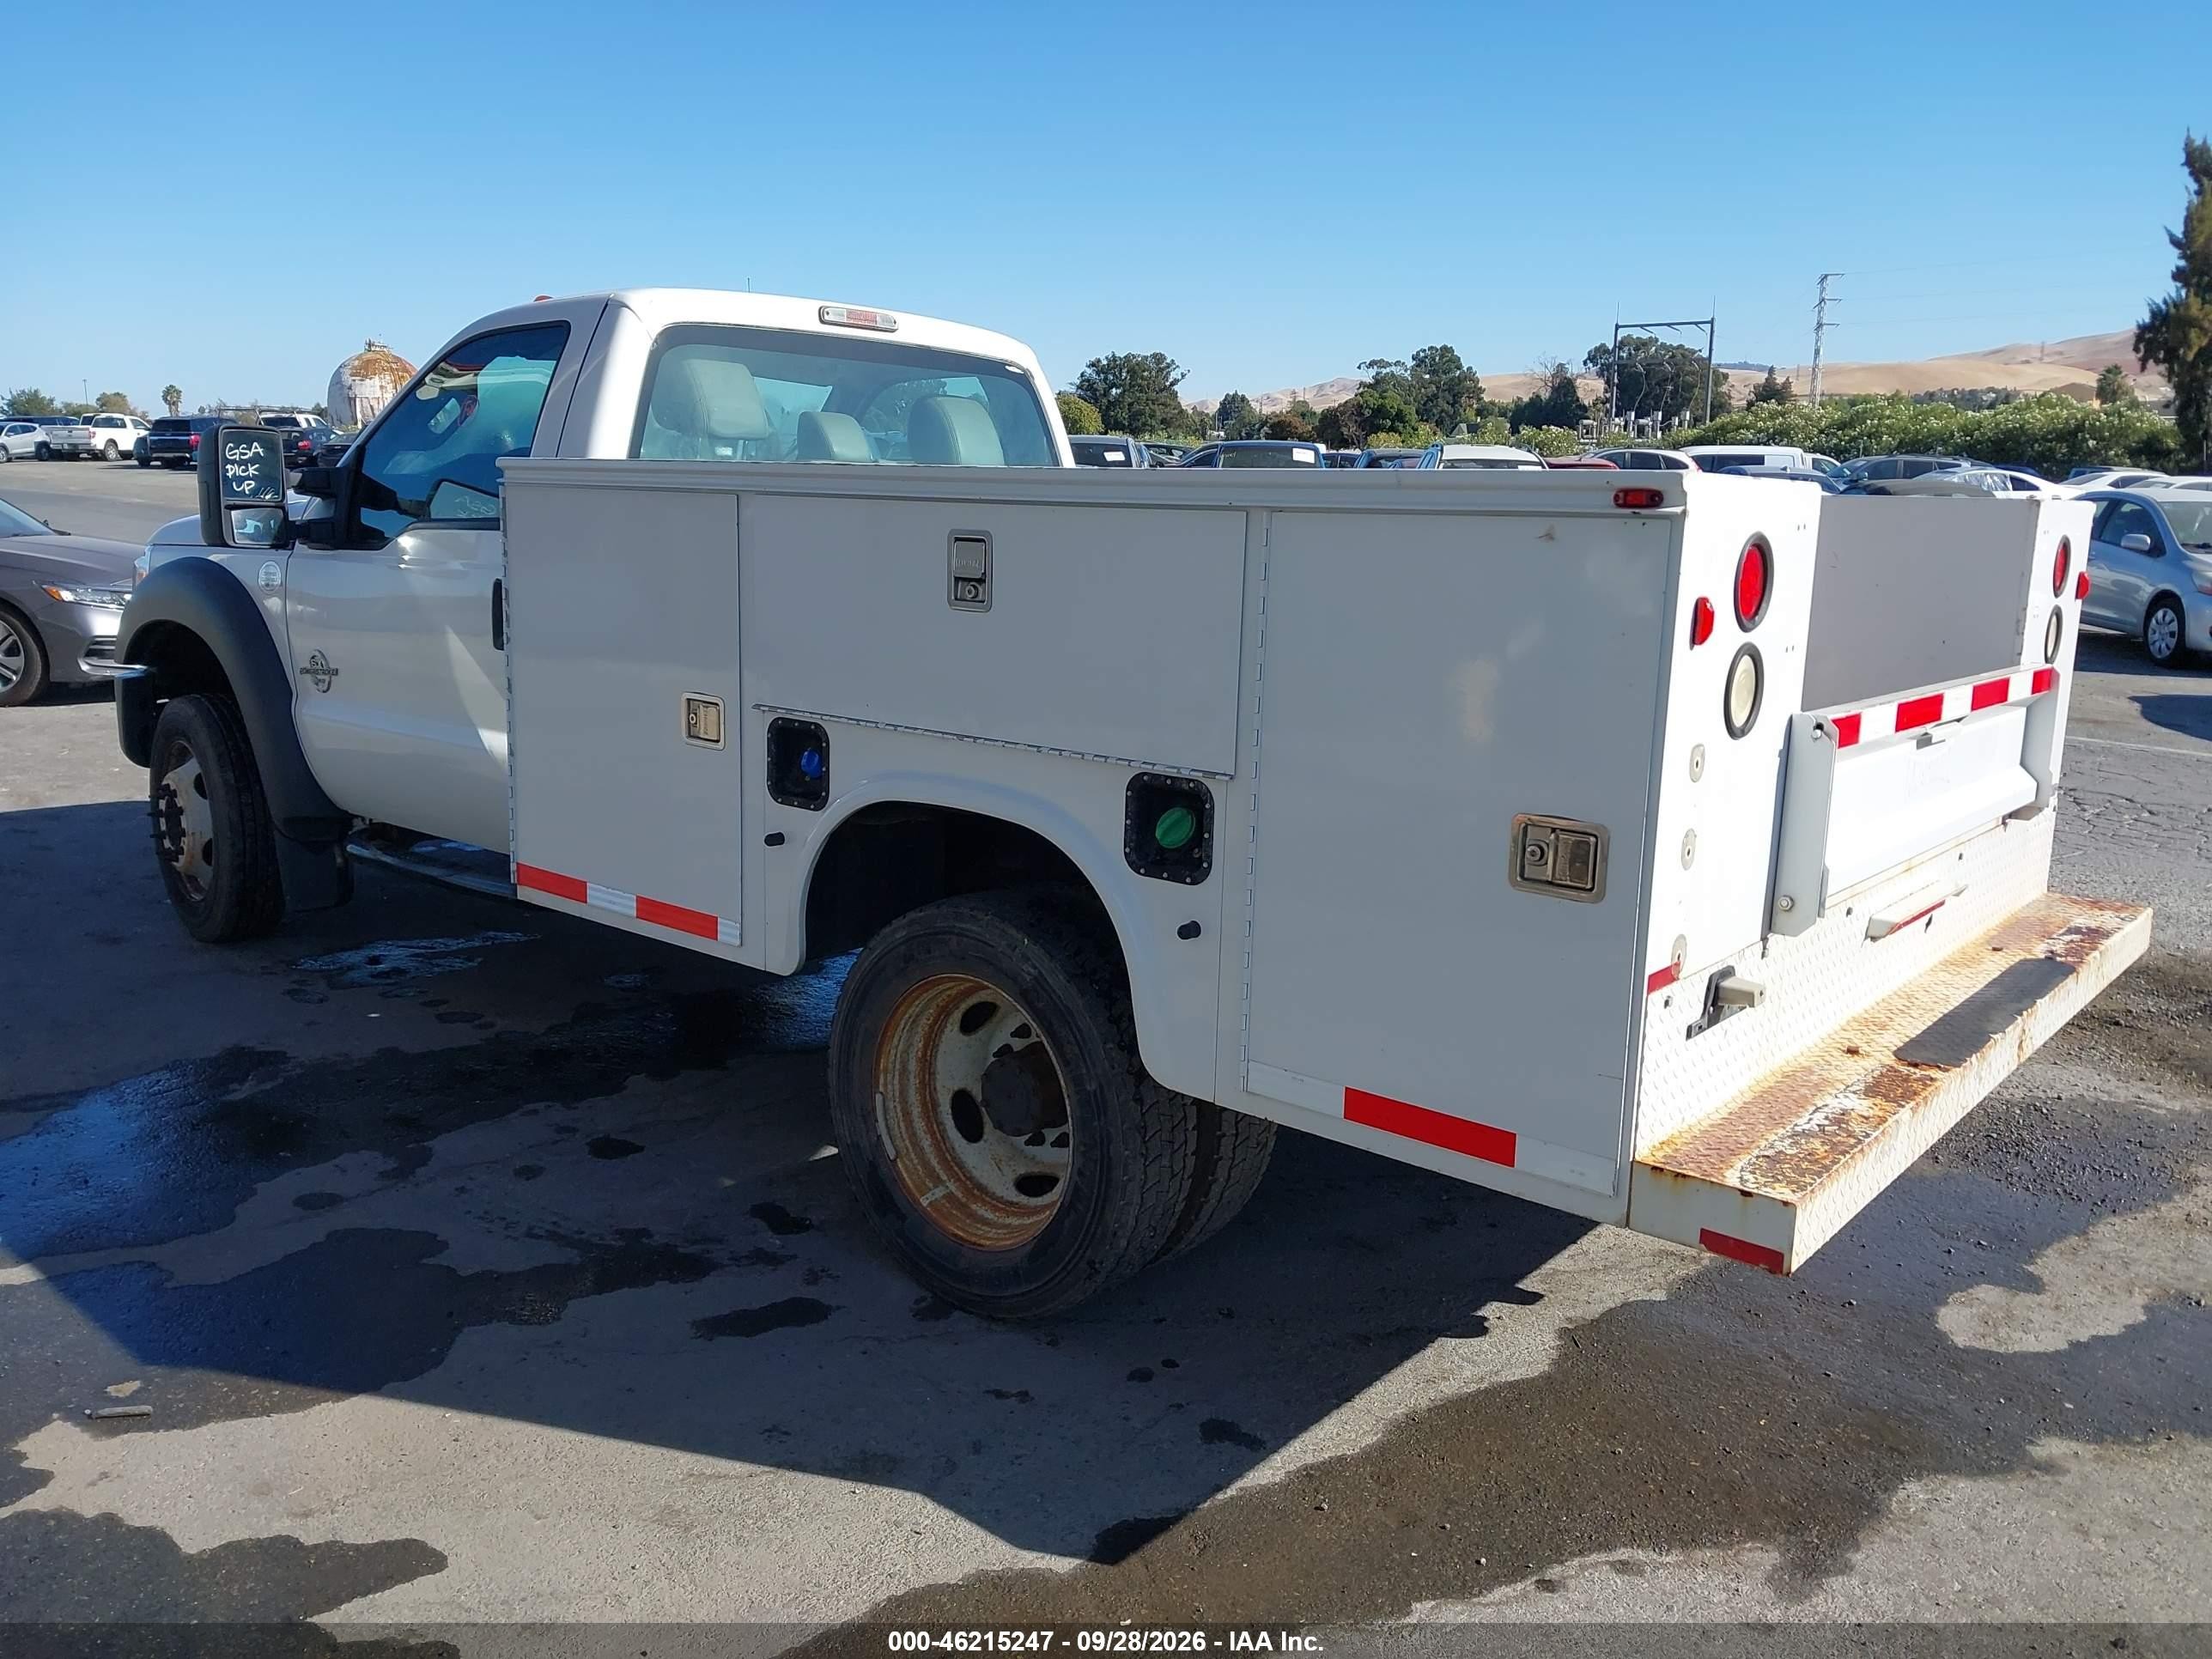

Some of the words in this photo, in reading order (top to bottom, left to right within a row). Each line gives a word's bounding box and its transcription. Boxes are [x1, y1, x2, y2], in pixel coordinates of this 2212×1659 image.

[225, 441, 264, 461] GSA
[225, 463, 260, 479] PICK
[232, 480, 256, 495] UP
